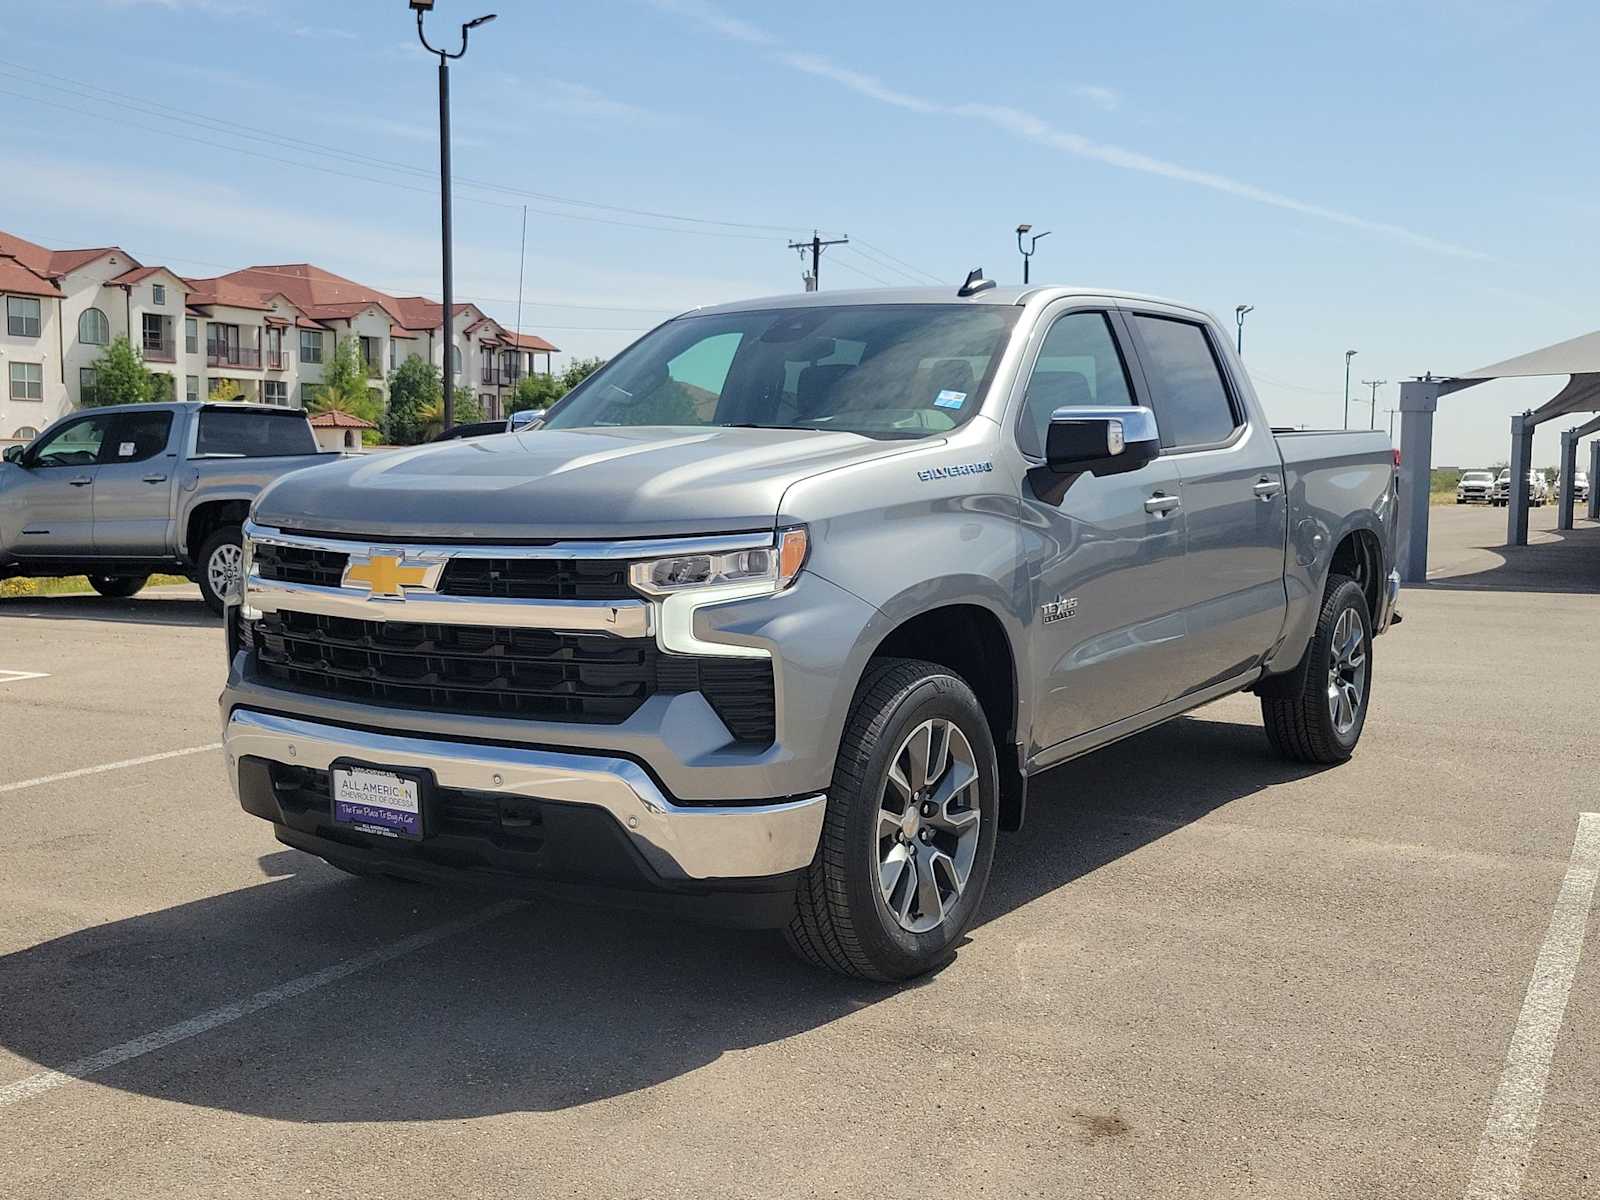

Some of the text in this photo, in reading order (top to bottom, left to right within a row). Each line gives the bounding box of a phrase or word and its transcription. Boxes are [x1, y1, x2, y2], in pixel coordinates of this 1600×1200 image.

[917, 461, 993, 482] SILVERADO
[1040, 595, 1078, 615] TEXAS
[342, 779, 360, 791] ALL
[341, 789, 414, 807] CHEVROLET OF ODESSA
[341, 803, 352, 813] The
[387, 811, 398, 824] Buy
[398, 813, 404, 822] A
